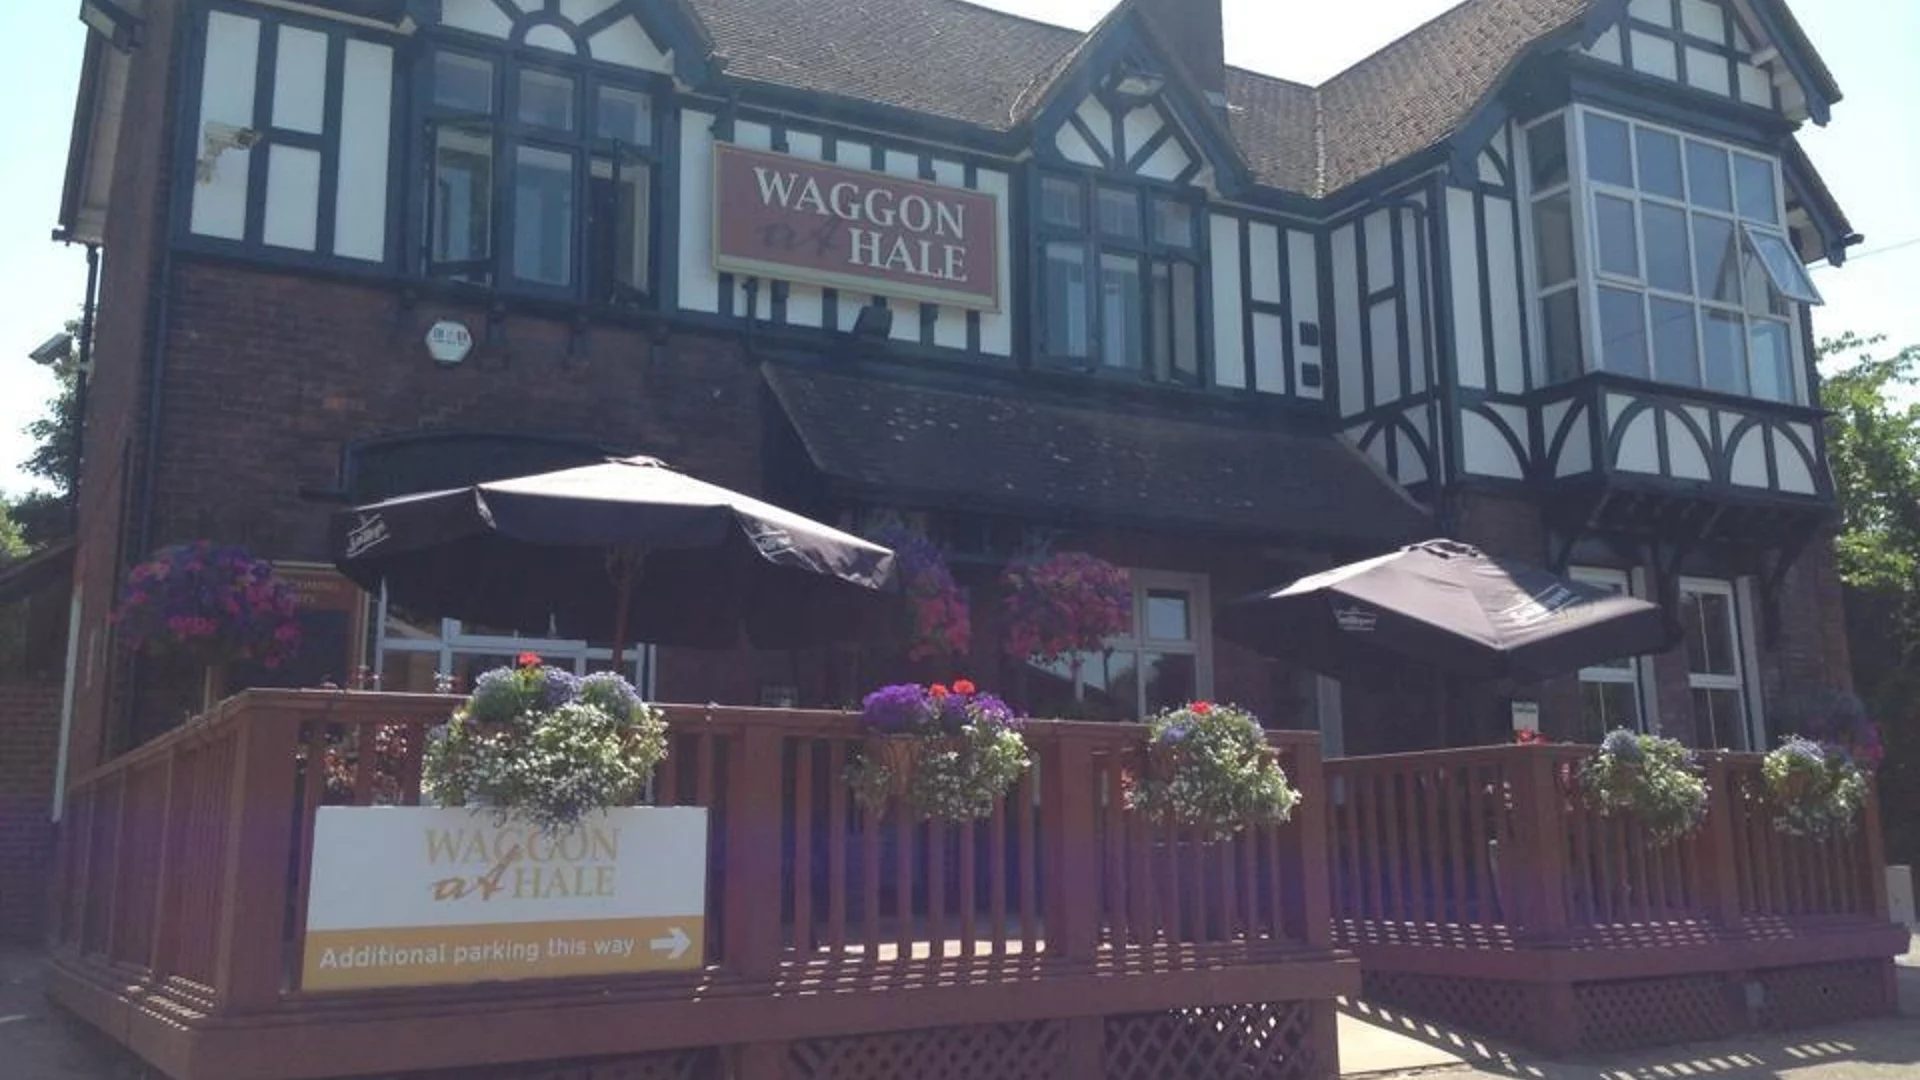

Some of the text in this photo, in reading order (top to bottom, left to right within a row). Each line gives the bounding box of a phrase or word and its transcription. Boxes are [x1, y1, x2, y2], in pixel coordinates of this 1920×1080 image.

[753, 166, 965, 239] WAGGON
[754, 216, 968, 282] at HALE
[429, 844, 616, 900] at HALE
[319, 936, 635, 969] Additional parking this way
